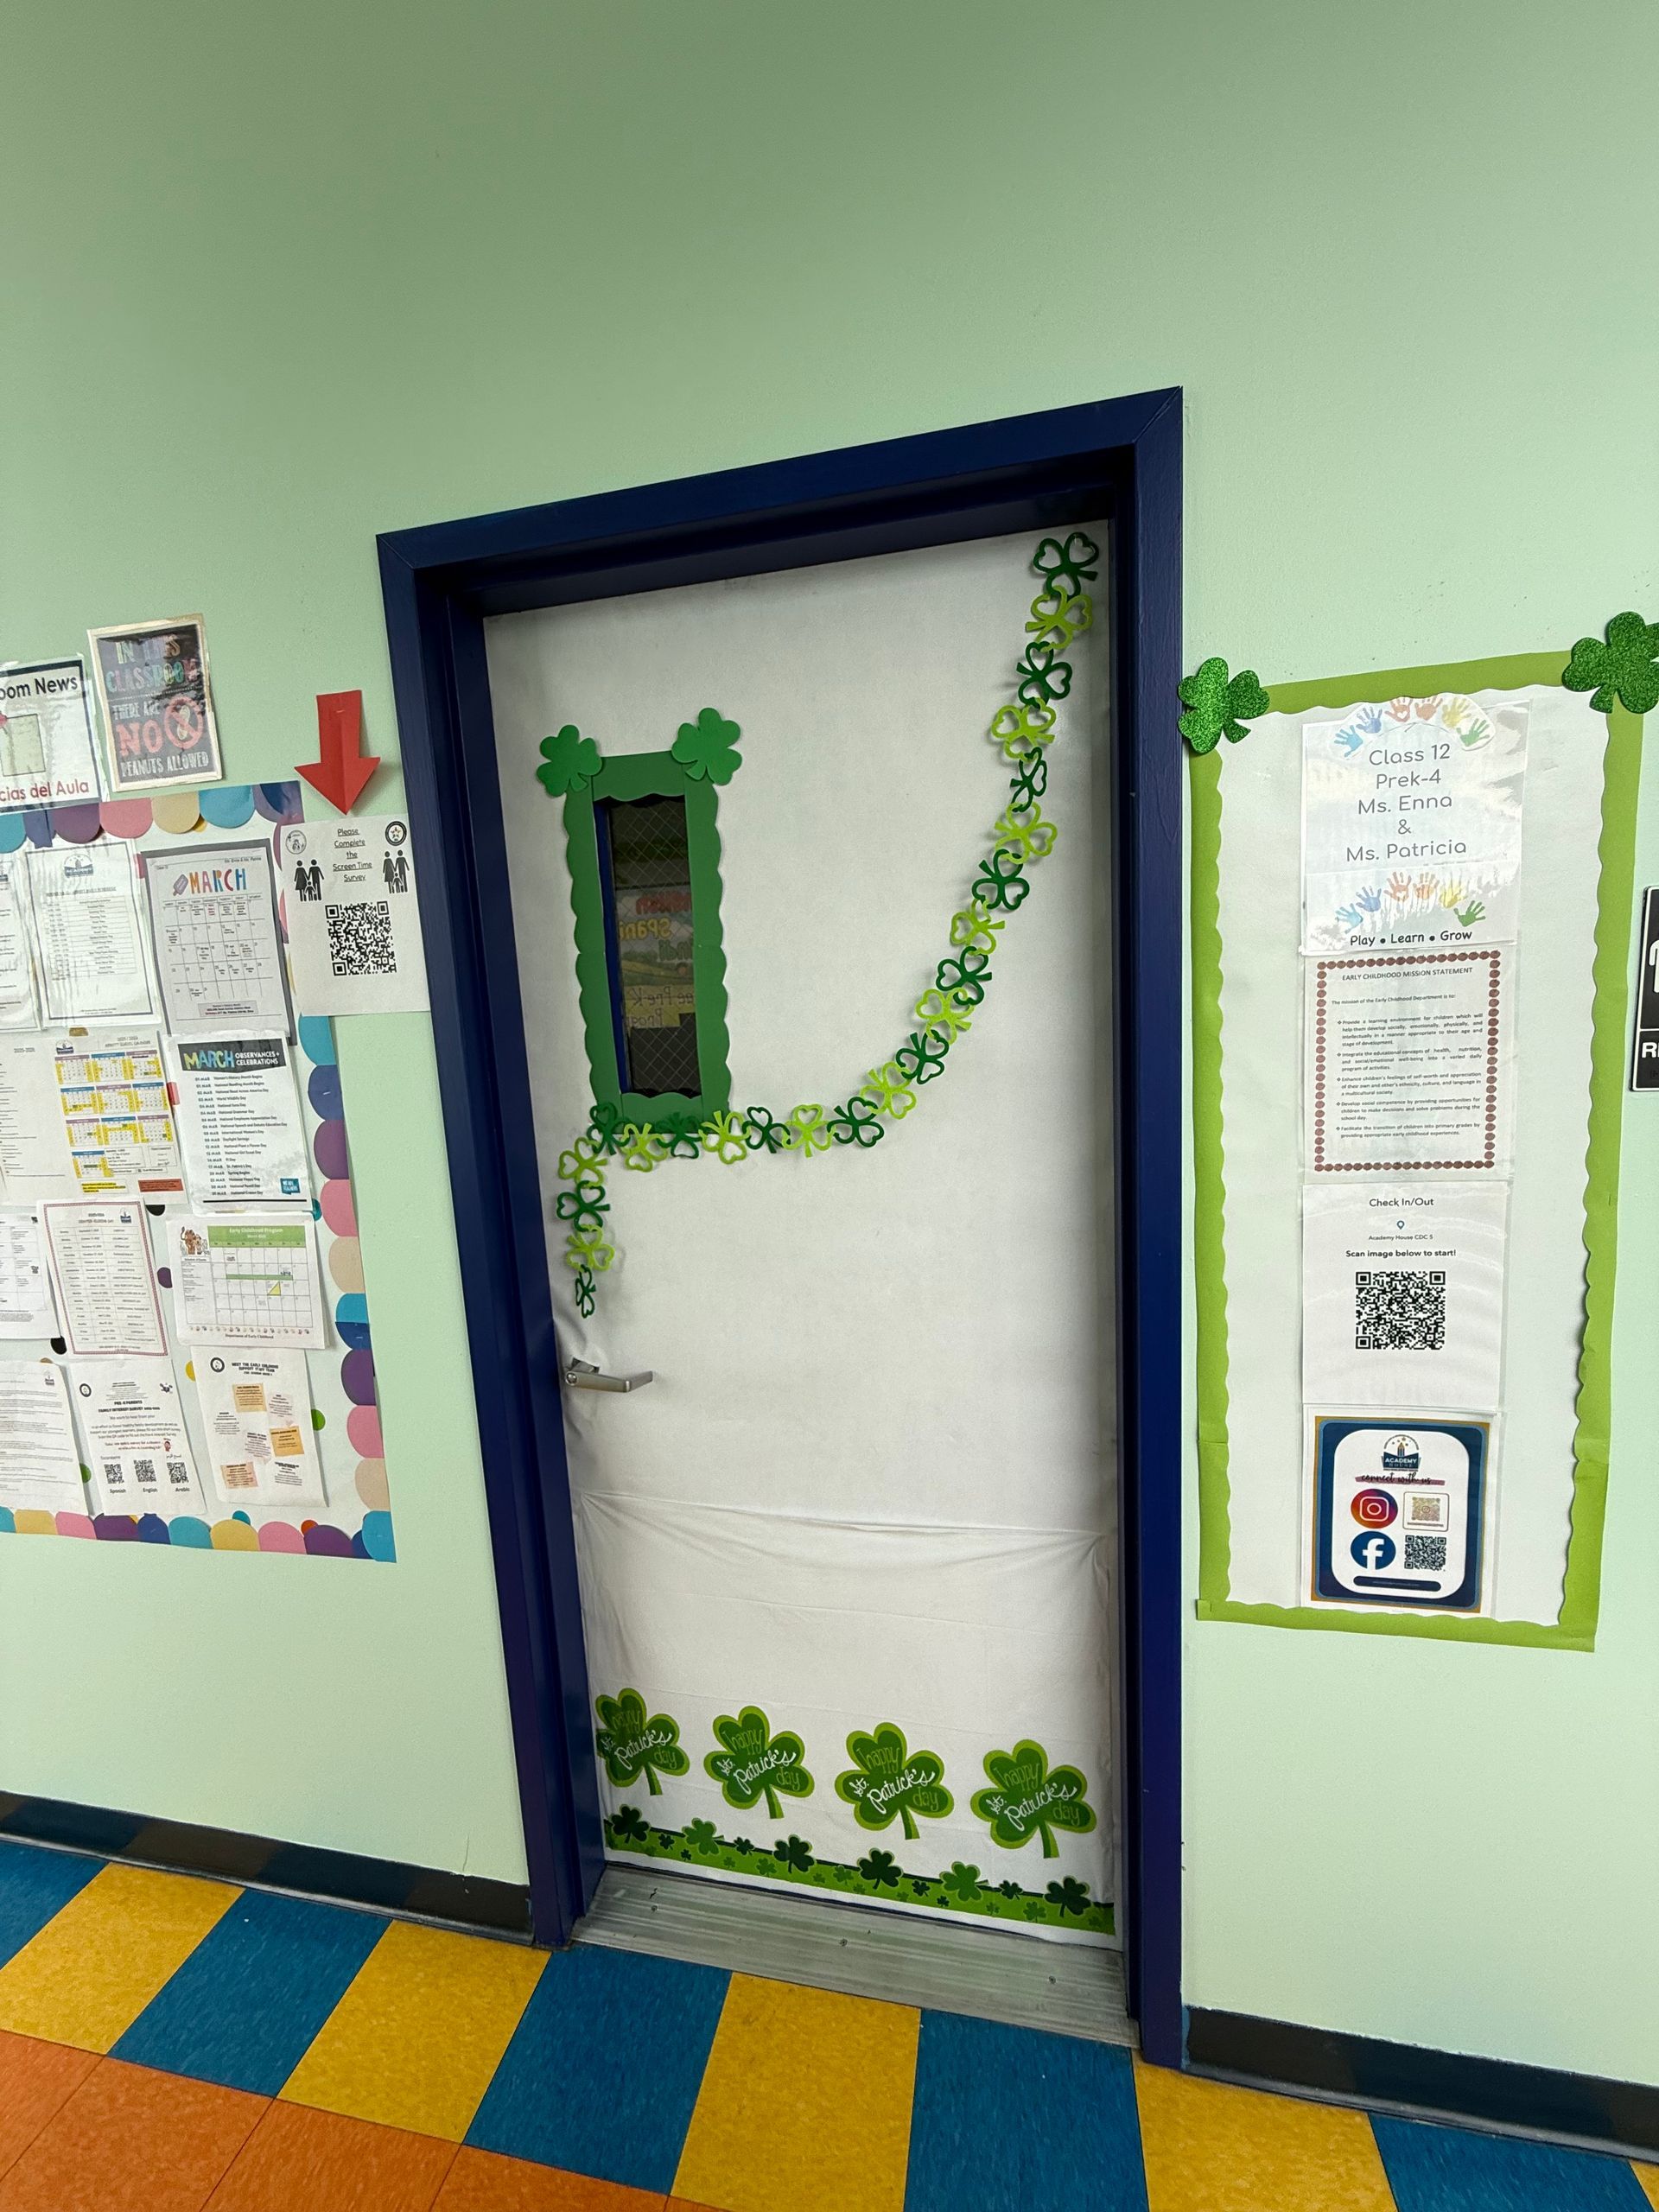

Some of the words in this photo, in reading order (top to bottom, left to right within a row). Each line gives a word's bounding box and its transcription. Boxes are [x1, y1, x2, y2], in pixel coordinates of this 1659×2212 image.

[116, 640, 137, 664] IN
[142, 633, 181, 660] THIS
[105, 658, 200, 693] CLASSROOM
[35, 677, 78, 695] News
[112, 702, 141, 720] THERE
[143, 700, 161, 715] ARE
[116, 719, 163, 756] NO
[121, 758, 164, 778] PEANUTS
[167, 751, 209, 772] ALLOWED
[1369, 747, 1424, 766] Class
[1432, 743, 1451, 761] 12
[30, 781, 52, 798] del
[56, 779, 89, 797] Aula
[1376, 768, 1441, 789] Prek-4
[1358, 798, 1392, 815] Ms.
[1399, 795, 1452, 811] Enna
[337, 828, 359, 836] Please
[1397, 818, 1412, 836] &
[334, 838, 366, 849] Complete
[1346, 846, 1380, 862] Ms.
[1386, 839, 1467, 859] Patricia
[333, 863, 357, 872] Screen
[357, 861, 372, 870] Time
[189, 868, 246, 894] MARCH
[344, 874, 366, 882] Survey
[1350, 934, 1376, 947] Play
[1390, 932, 1425, 944] Learn
[1440, 930, 1472, 942] Grow
[183, 1050, 235, 1070] MARCH
[1369, 1198, 1399, 1207] Check
[1402, 1198, 1434, 1206] In/Out
[1367, 1249, 1393, 1258] image
[1362, 1472, 1395, 1482] connect
[1397, 1471, 1420, 1484] with
[653, 1746, 677, 1770] day
[776, 1766, 799, 1791] day
[913, 1786, 938, 1811] day
[1052, 1801, 1079, 1826] day
